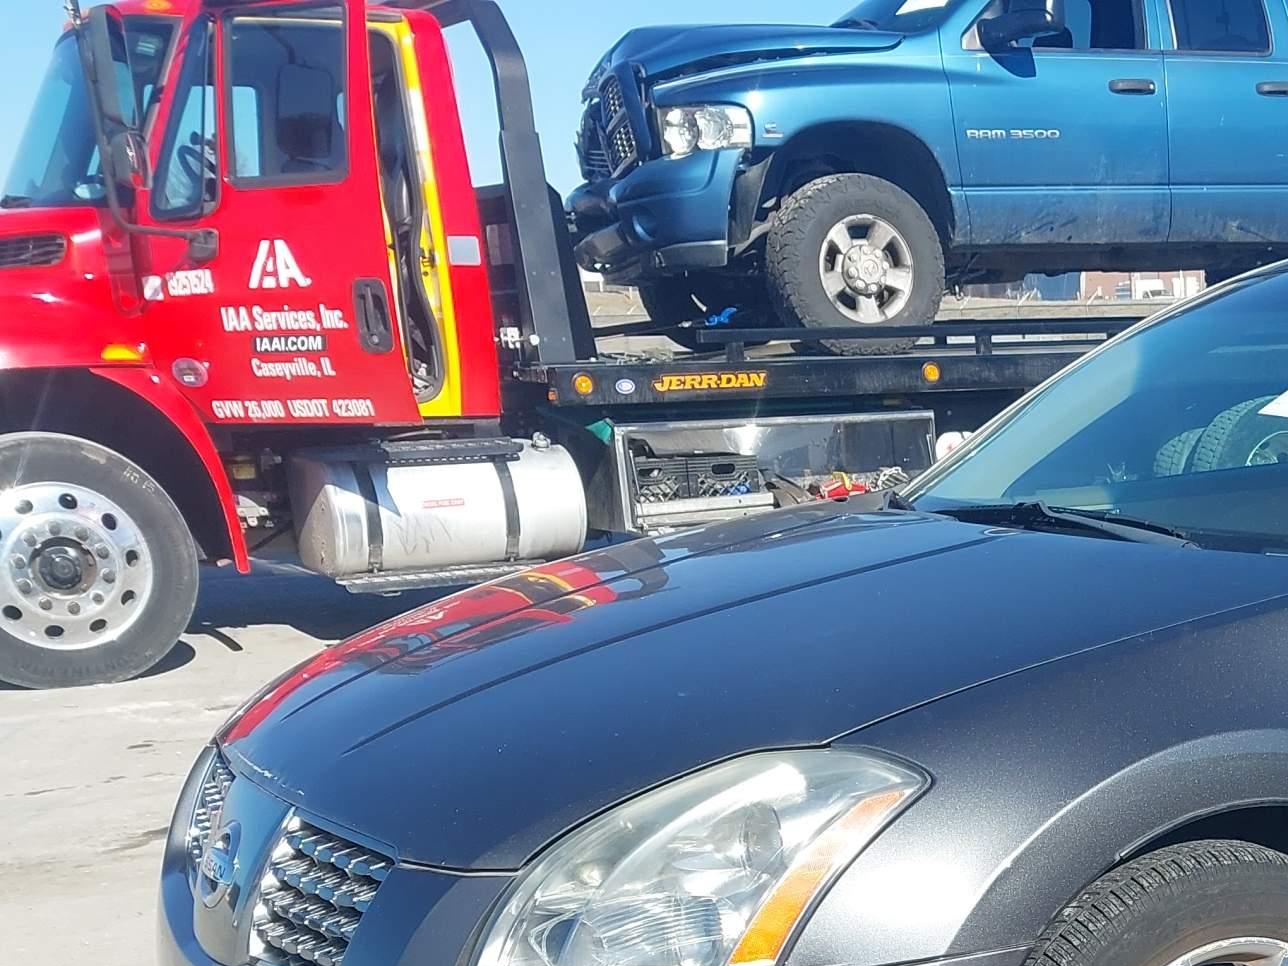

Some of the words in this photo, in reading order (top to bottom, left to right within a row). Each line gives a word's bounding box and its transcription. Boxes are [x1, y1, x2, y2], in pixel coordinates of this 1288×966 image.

[966, 129, 1006, 139] RAM
[1010, 129, 1060, 139] 3500
[220, 306, 252, 332] IAA
[252, 304, 321, 331] Services,
[319, 303, 349, 329] Inc.
[256, 335, 323, 352] IAAI.COM
[251, 357, 322, 381] Caseyville,
[212, 400, 245, 418] GVW
[287, 399, 330, 418] USDOT
[332, 399, 375, 417] 423081
